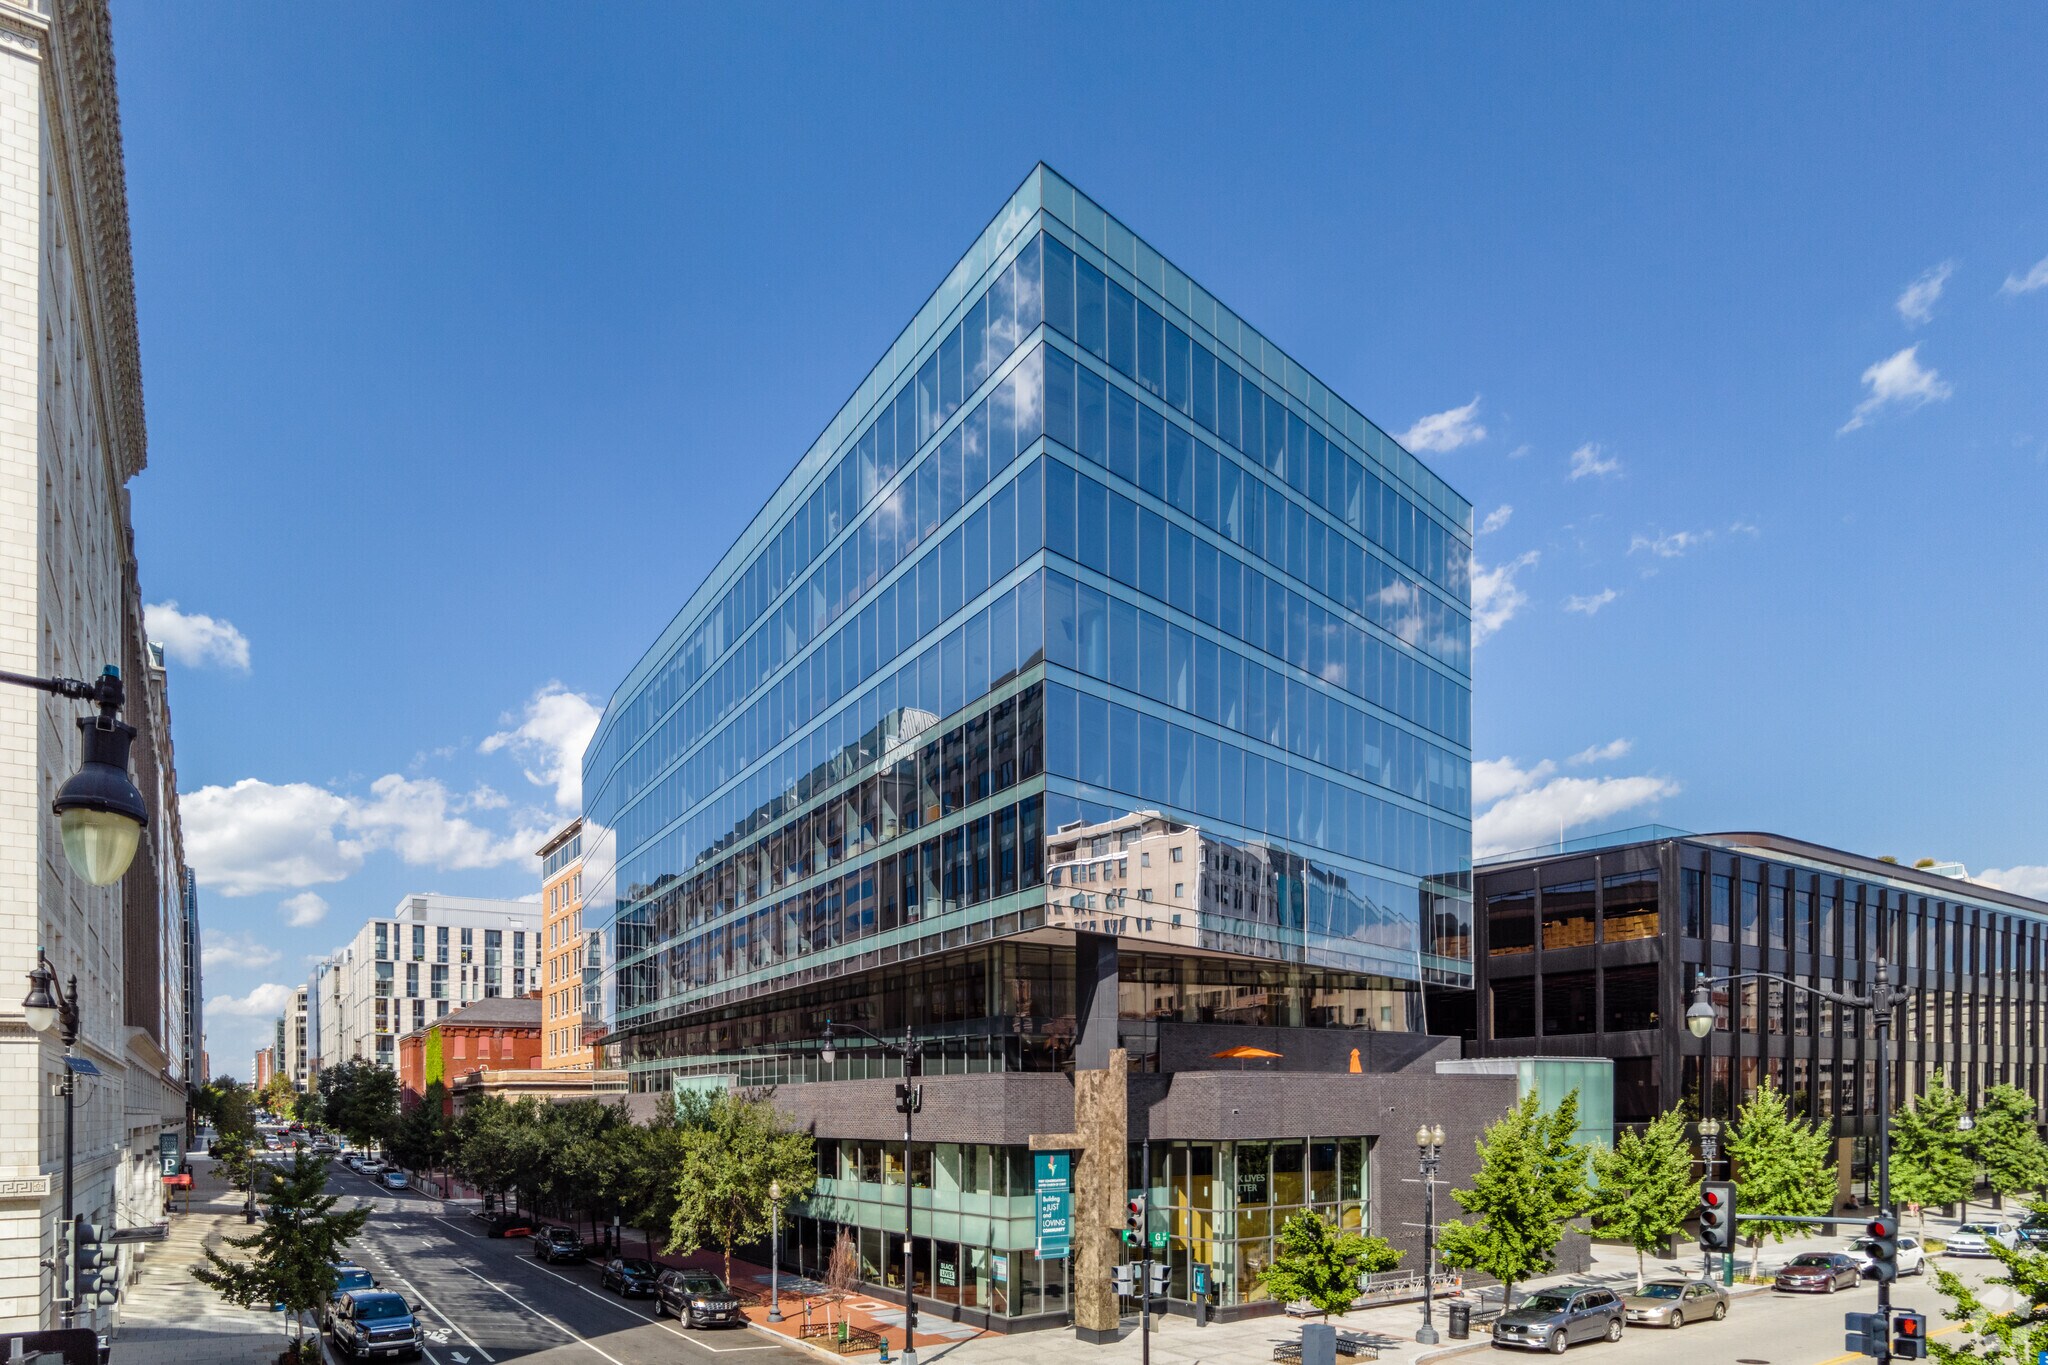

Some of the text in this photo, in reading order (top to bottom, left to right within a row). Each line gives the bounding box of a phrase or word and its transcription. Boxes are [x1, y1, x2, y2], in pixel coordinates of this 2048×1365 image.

[164, 1158, 176, 1171] P
[1244, 1174, 1265, 1182] LIVES
[1043, 1195, 1061, 1203] Building
[1047, 1203, 1060, 1212] JUST
[1043, 1218, 1066, 1227] LOVING
[1154, 1232, 1161, 1241] G
